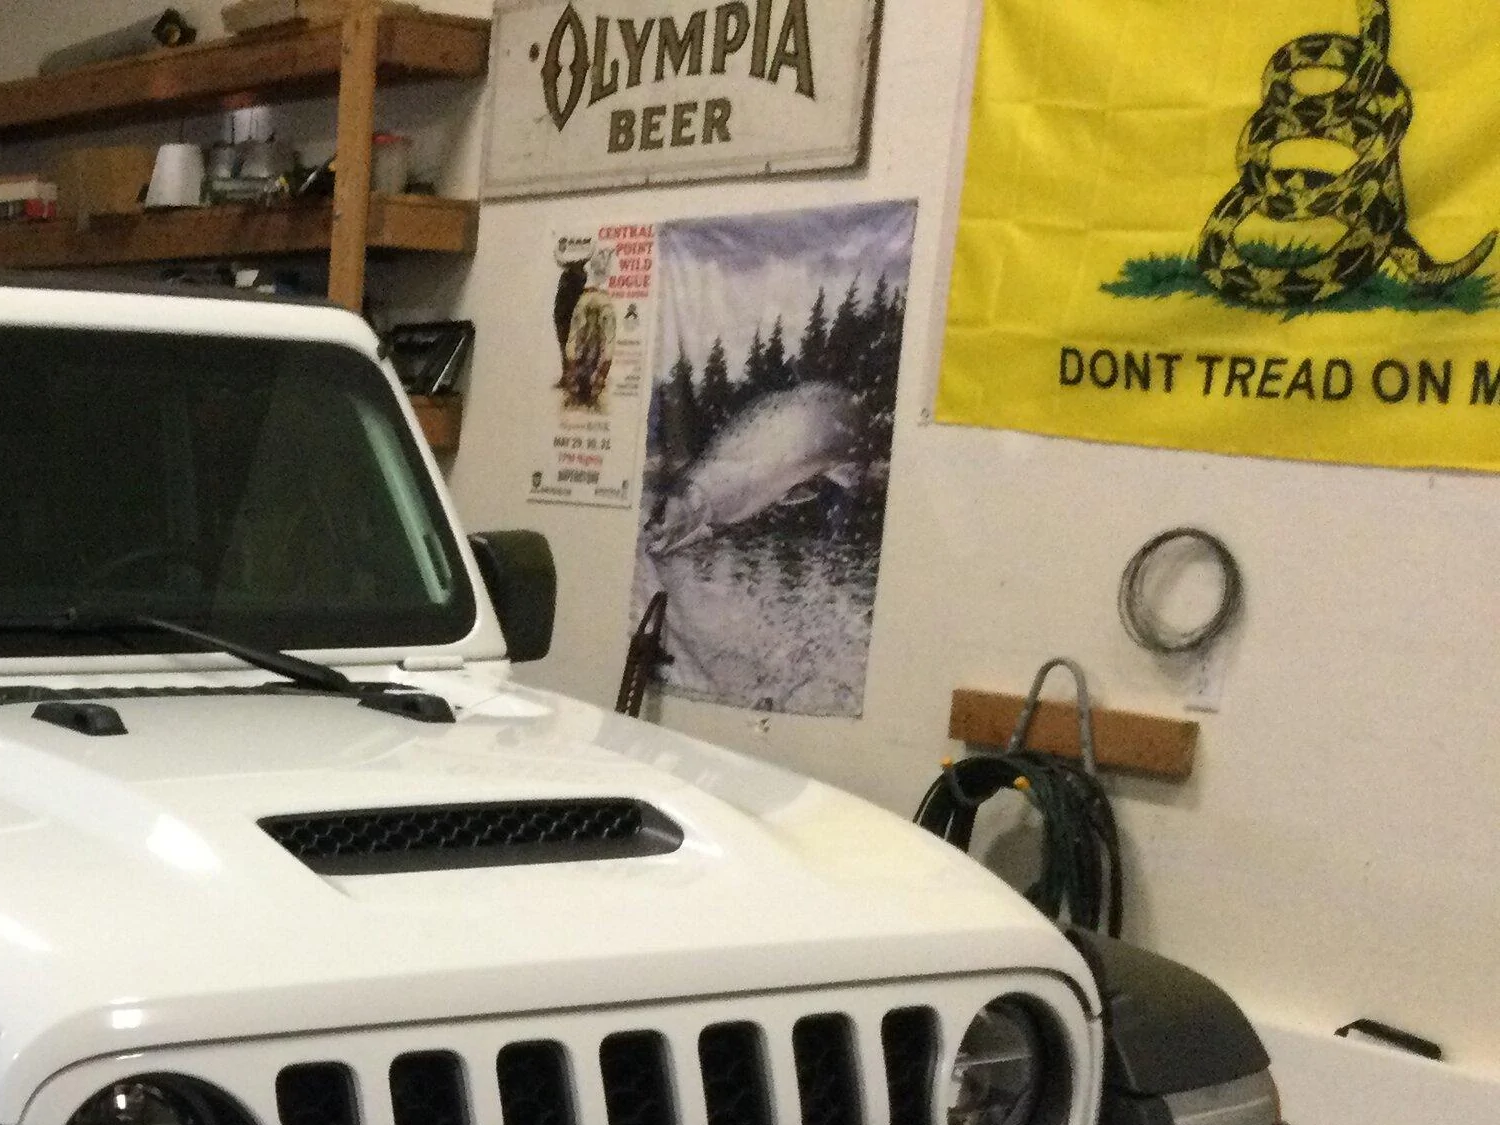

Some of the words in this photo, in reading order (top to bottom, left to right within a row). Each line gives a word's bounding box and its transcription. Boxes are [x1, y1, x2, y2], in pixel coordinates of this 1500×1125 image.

[541, 0, 816, 132] OLYMPIA
[607, 97, 732, 153] BEER
[598, 224, 654, 241] CENTRAL
[615, 241, 654, 256] POINT
[619, 257, 652, 273] WILD
[608, 274, 651, 289] ROGUE
[1059, 345, 1183, 393] DONT
[1196, 353, 1354, 401] TREAD
[1371, 358, 1452, 405] ON
[1469, 359, 1500, 405] M
